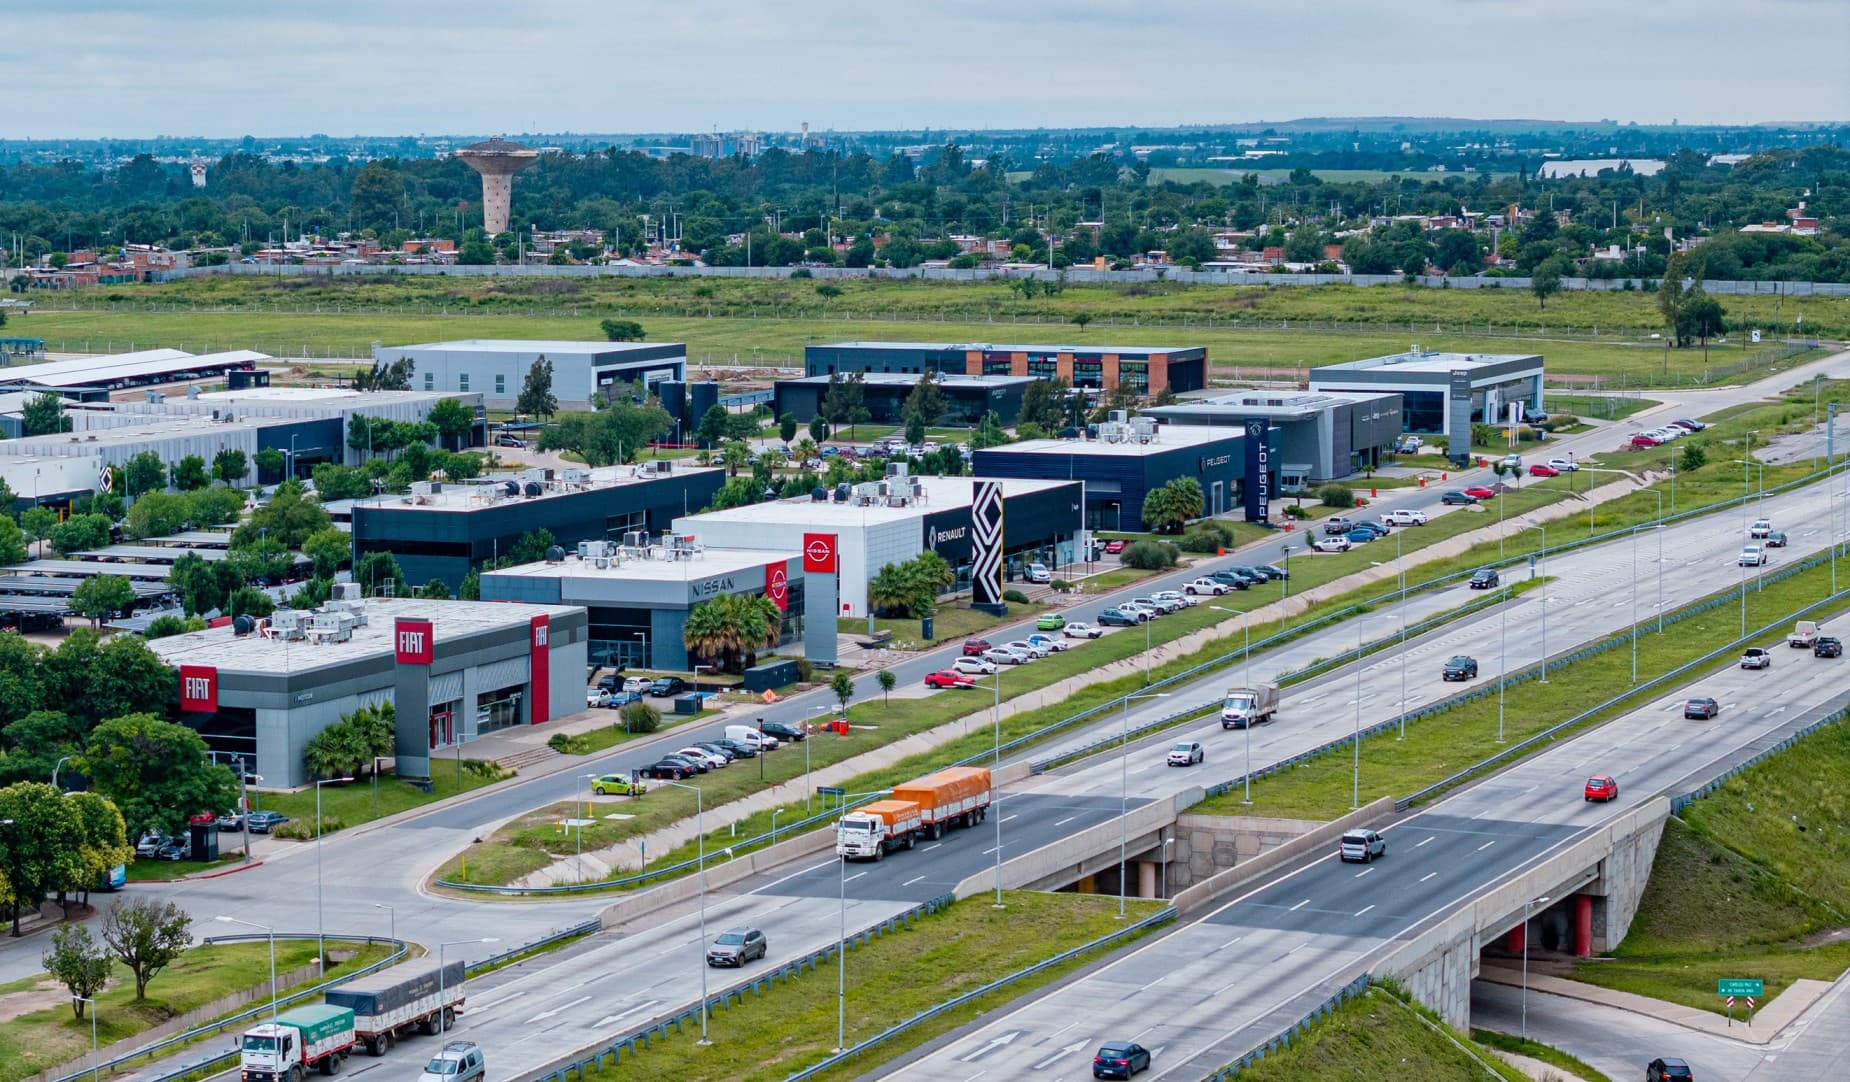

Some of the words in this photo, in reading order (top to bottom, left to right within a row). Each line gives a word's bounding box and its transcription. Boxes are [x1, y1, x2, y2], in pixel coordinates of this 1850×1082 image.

[1259, 442, 1267, 517] PEUGEOT
[937, 527, 966, 543] RENAULT
[692, 577, 735, 597] NISSAN
[400, 631, 424, 654] FIAT
[535, 625, 548, 647] FIAT
[186, 677, 210, 700] FIAT
